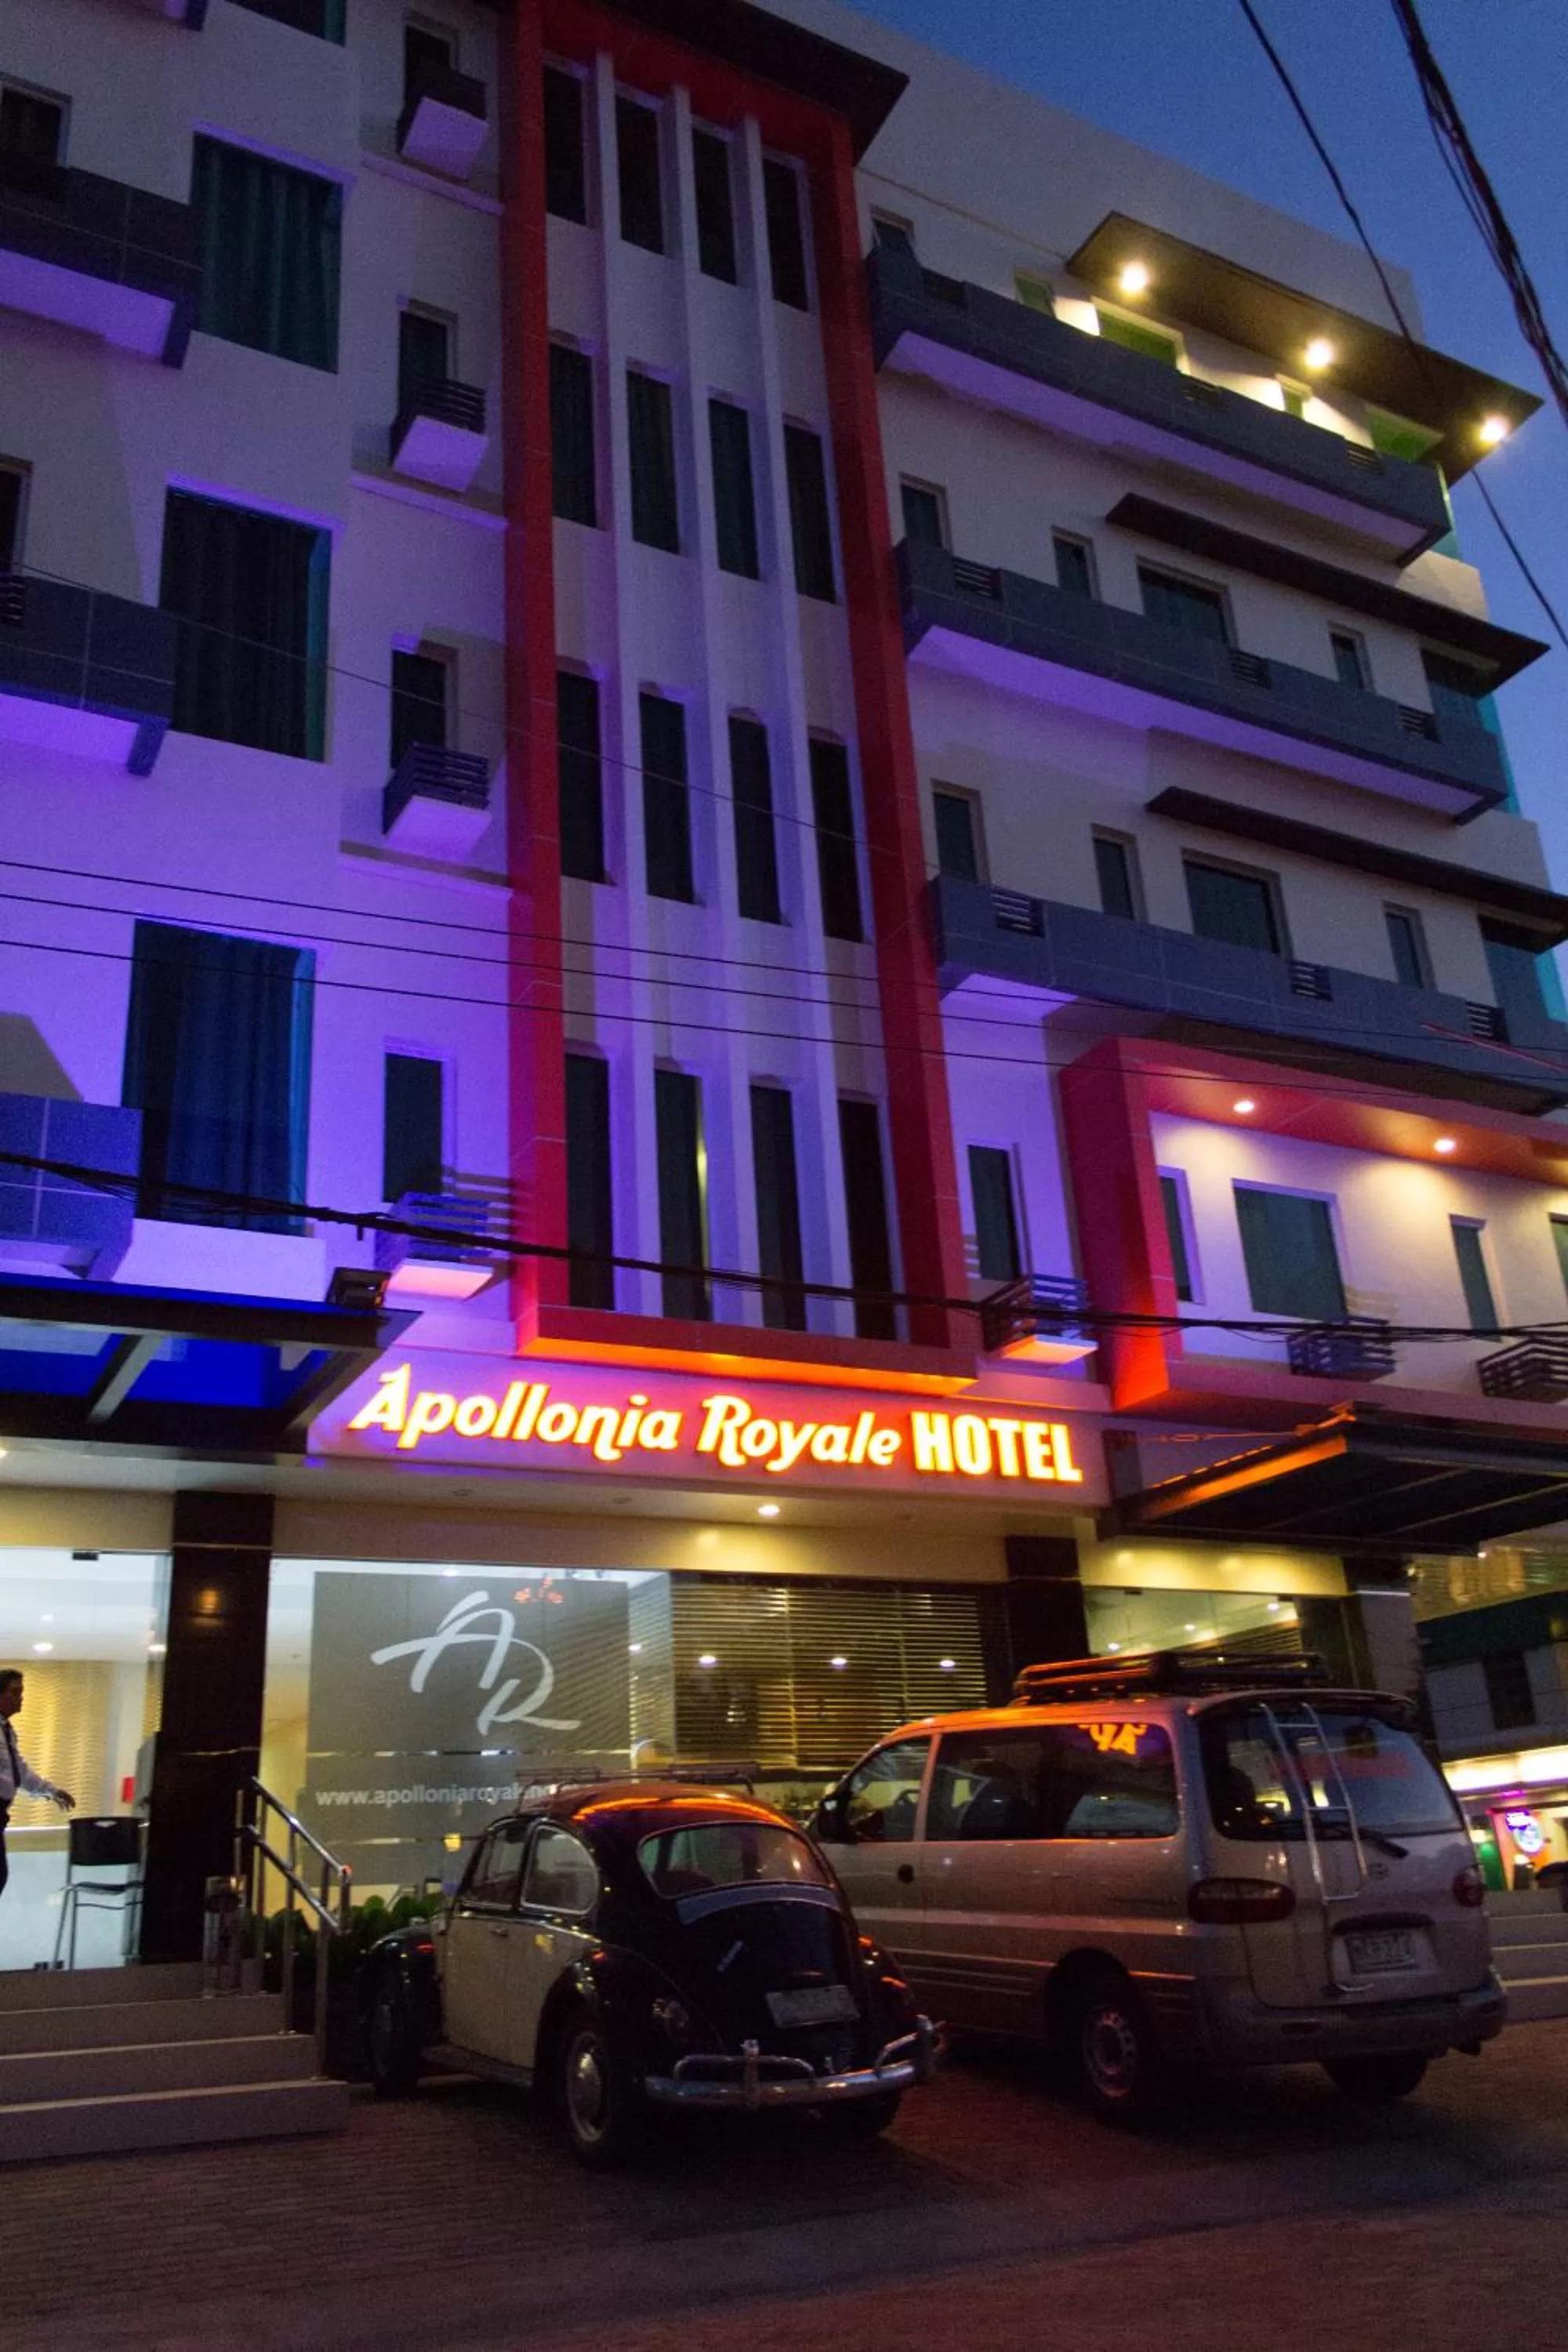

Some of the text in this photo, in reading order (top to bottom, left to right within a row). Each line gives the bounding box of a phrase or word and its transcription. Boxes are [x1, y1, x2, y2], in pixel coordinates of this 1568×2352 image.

[348, 1363, 1083, 1483] Apollonia Royale HOTEL
